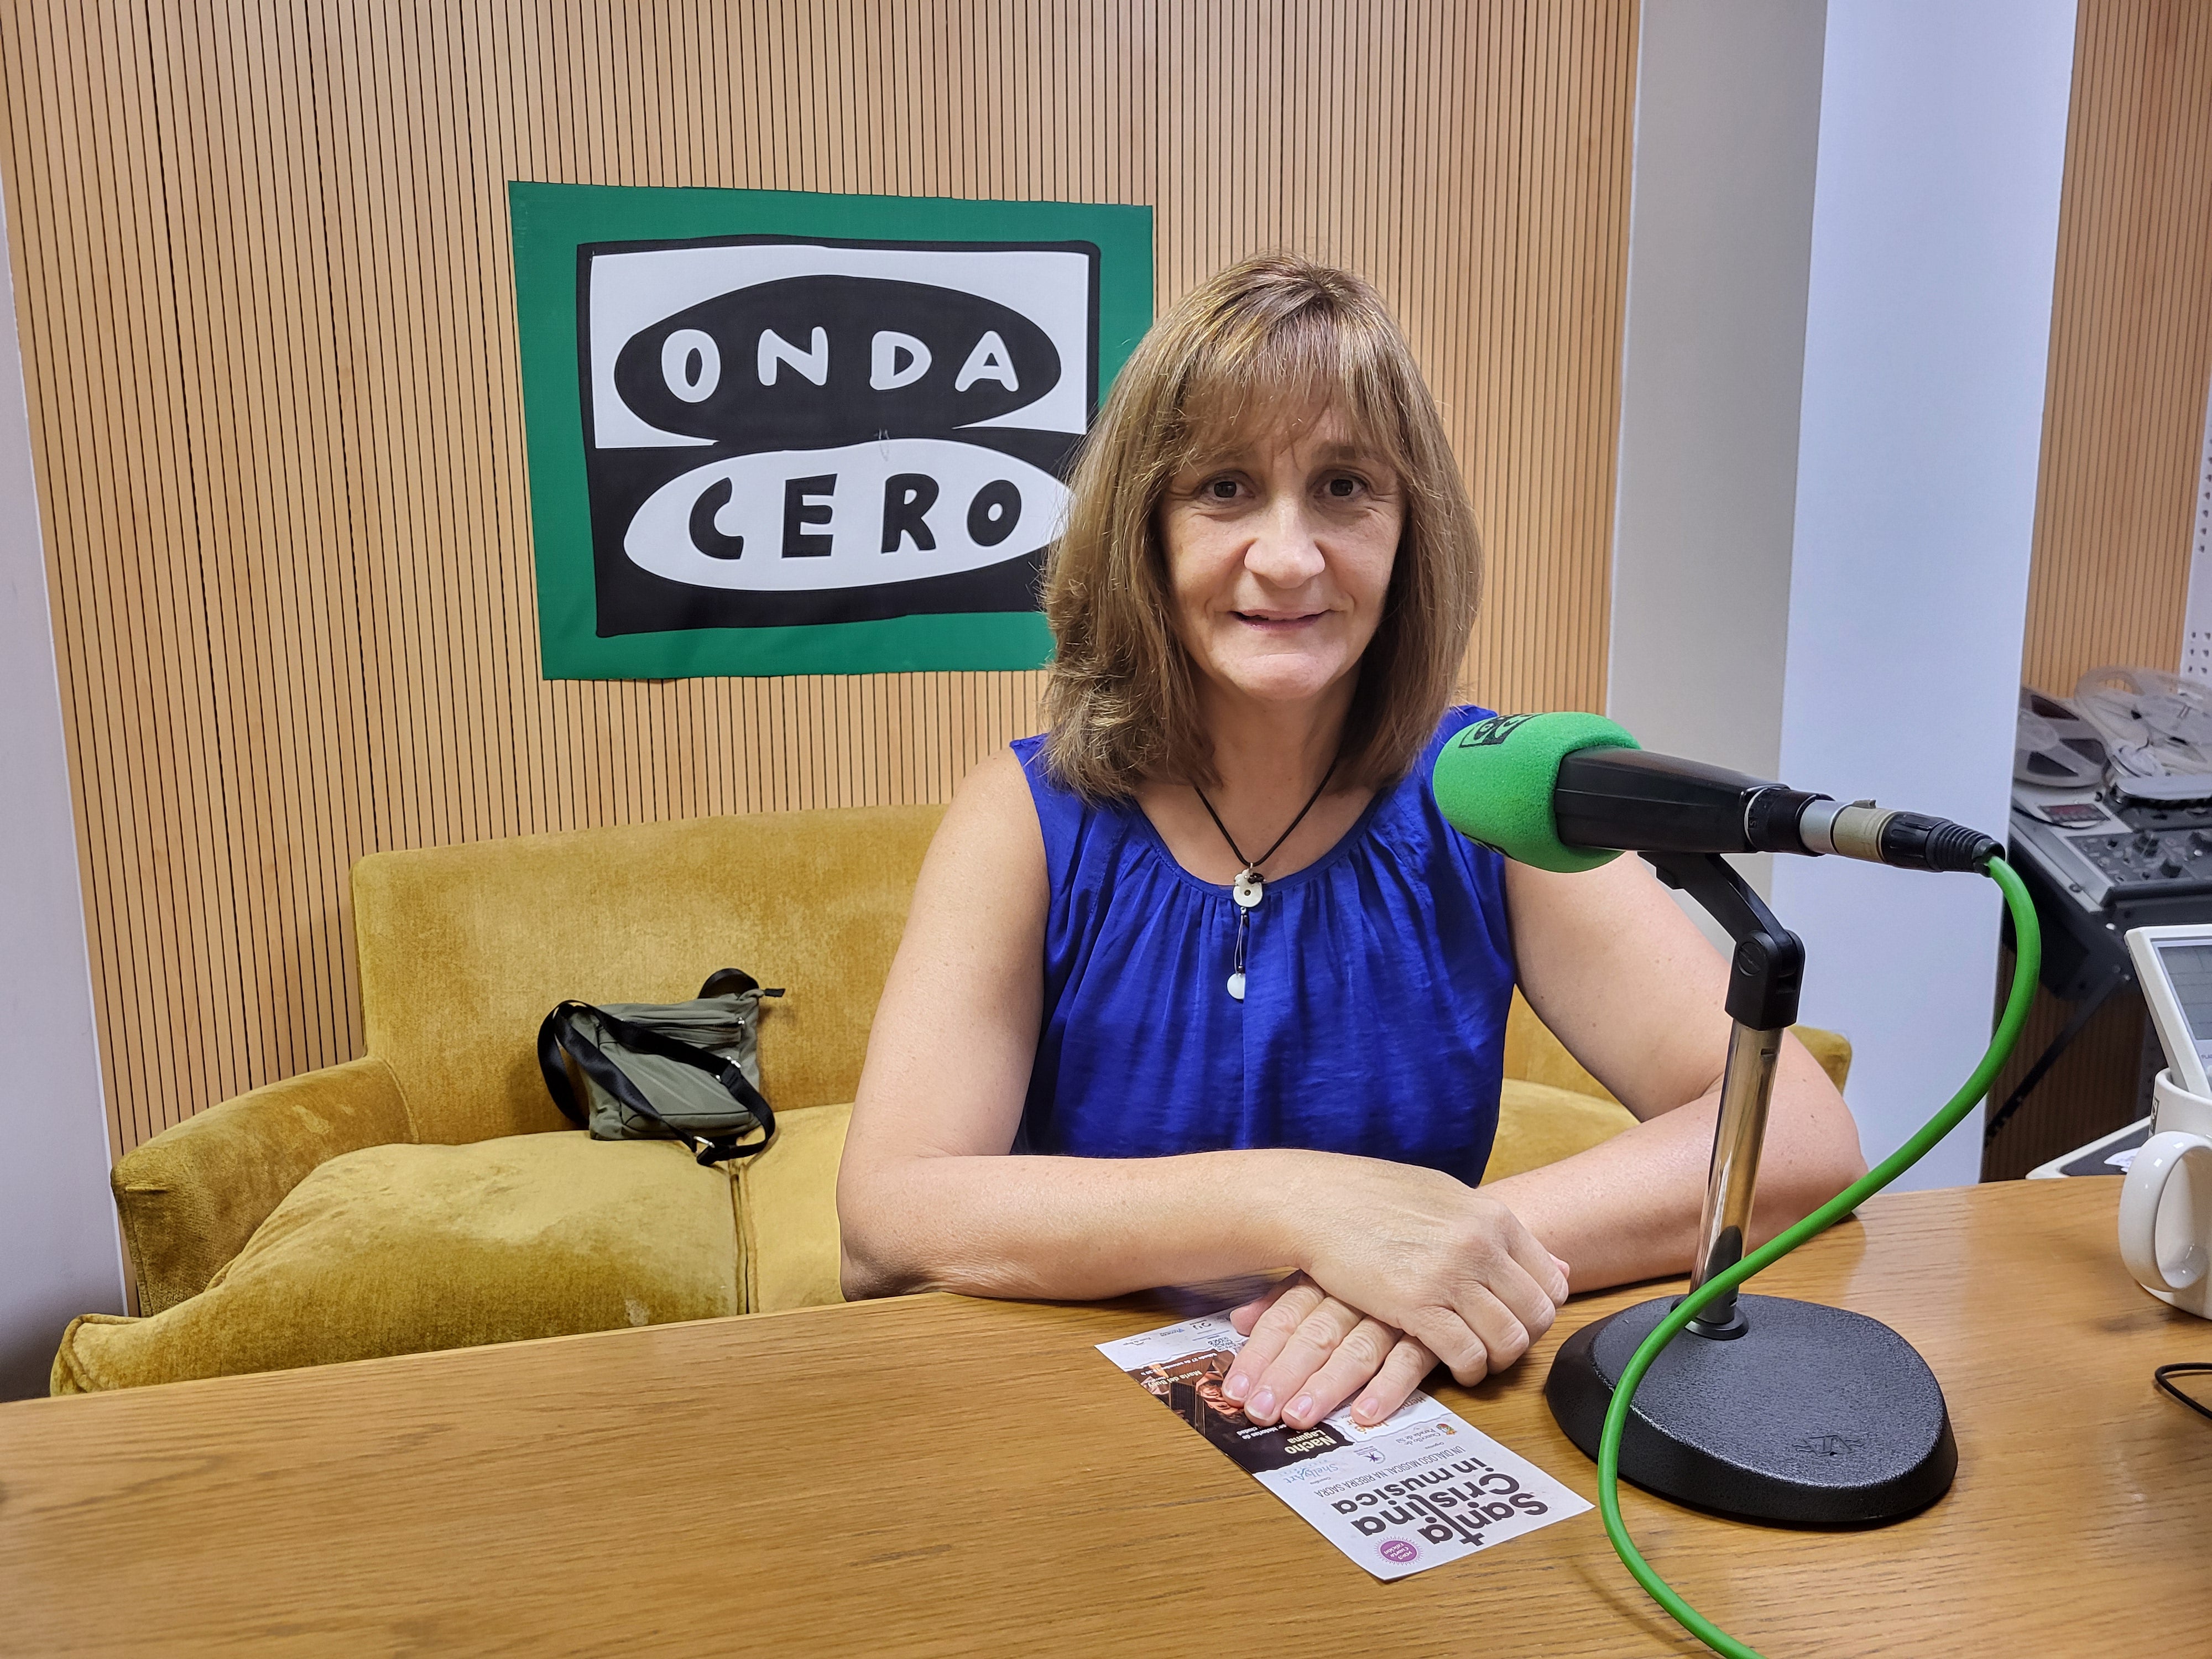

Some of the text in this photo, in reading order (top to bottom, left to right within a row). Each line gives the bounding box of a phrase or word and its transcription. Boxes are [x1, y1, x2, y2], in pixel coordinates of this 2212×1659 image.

[661, 327, 1019, 403] ONDA
[689, 473, 1021, 559] CERO
[1180, 1369, 1203, 1379] María
[1237, 1426, 1258, 1436] ciudad
[1249, 1426, 1279, 1439] historias
[1286, 1430, 1326, 1443] Laguna
[1412, 1428, 1436, 1439] Parada
[1413, 1432, 1440, 1444] Concello
[1284, 1436, 1337, 1454] Nacho
[1452, 1446, 1465, 1455] UN
[1386, 1460, 1421, 1474] MUSICAL
[1331, 1458, 1494, 1514] in musica
[1343, 1474, 1376, 1489] RIBEIRA
[1314, 1484, 1345, 1498] SACRA
[1350, 1474, 1520, 1536] Cristina
[1416, 1493, 1548, 1546] Santa
